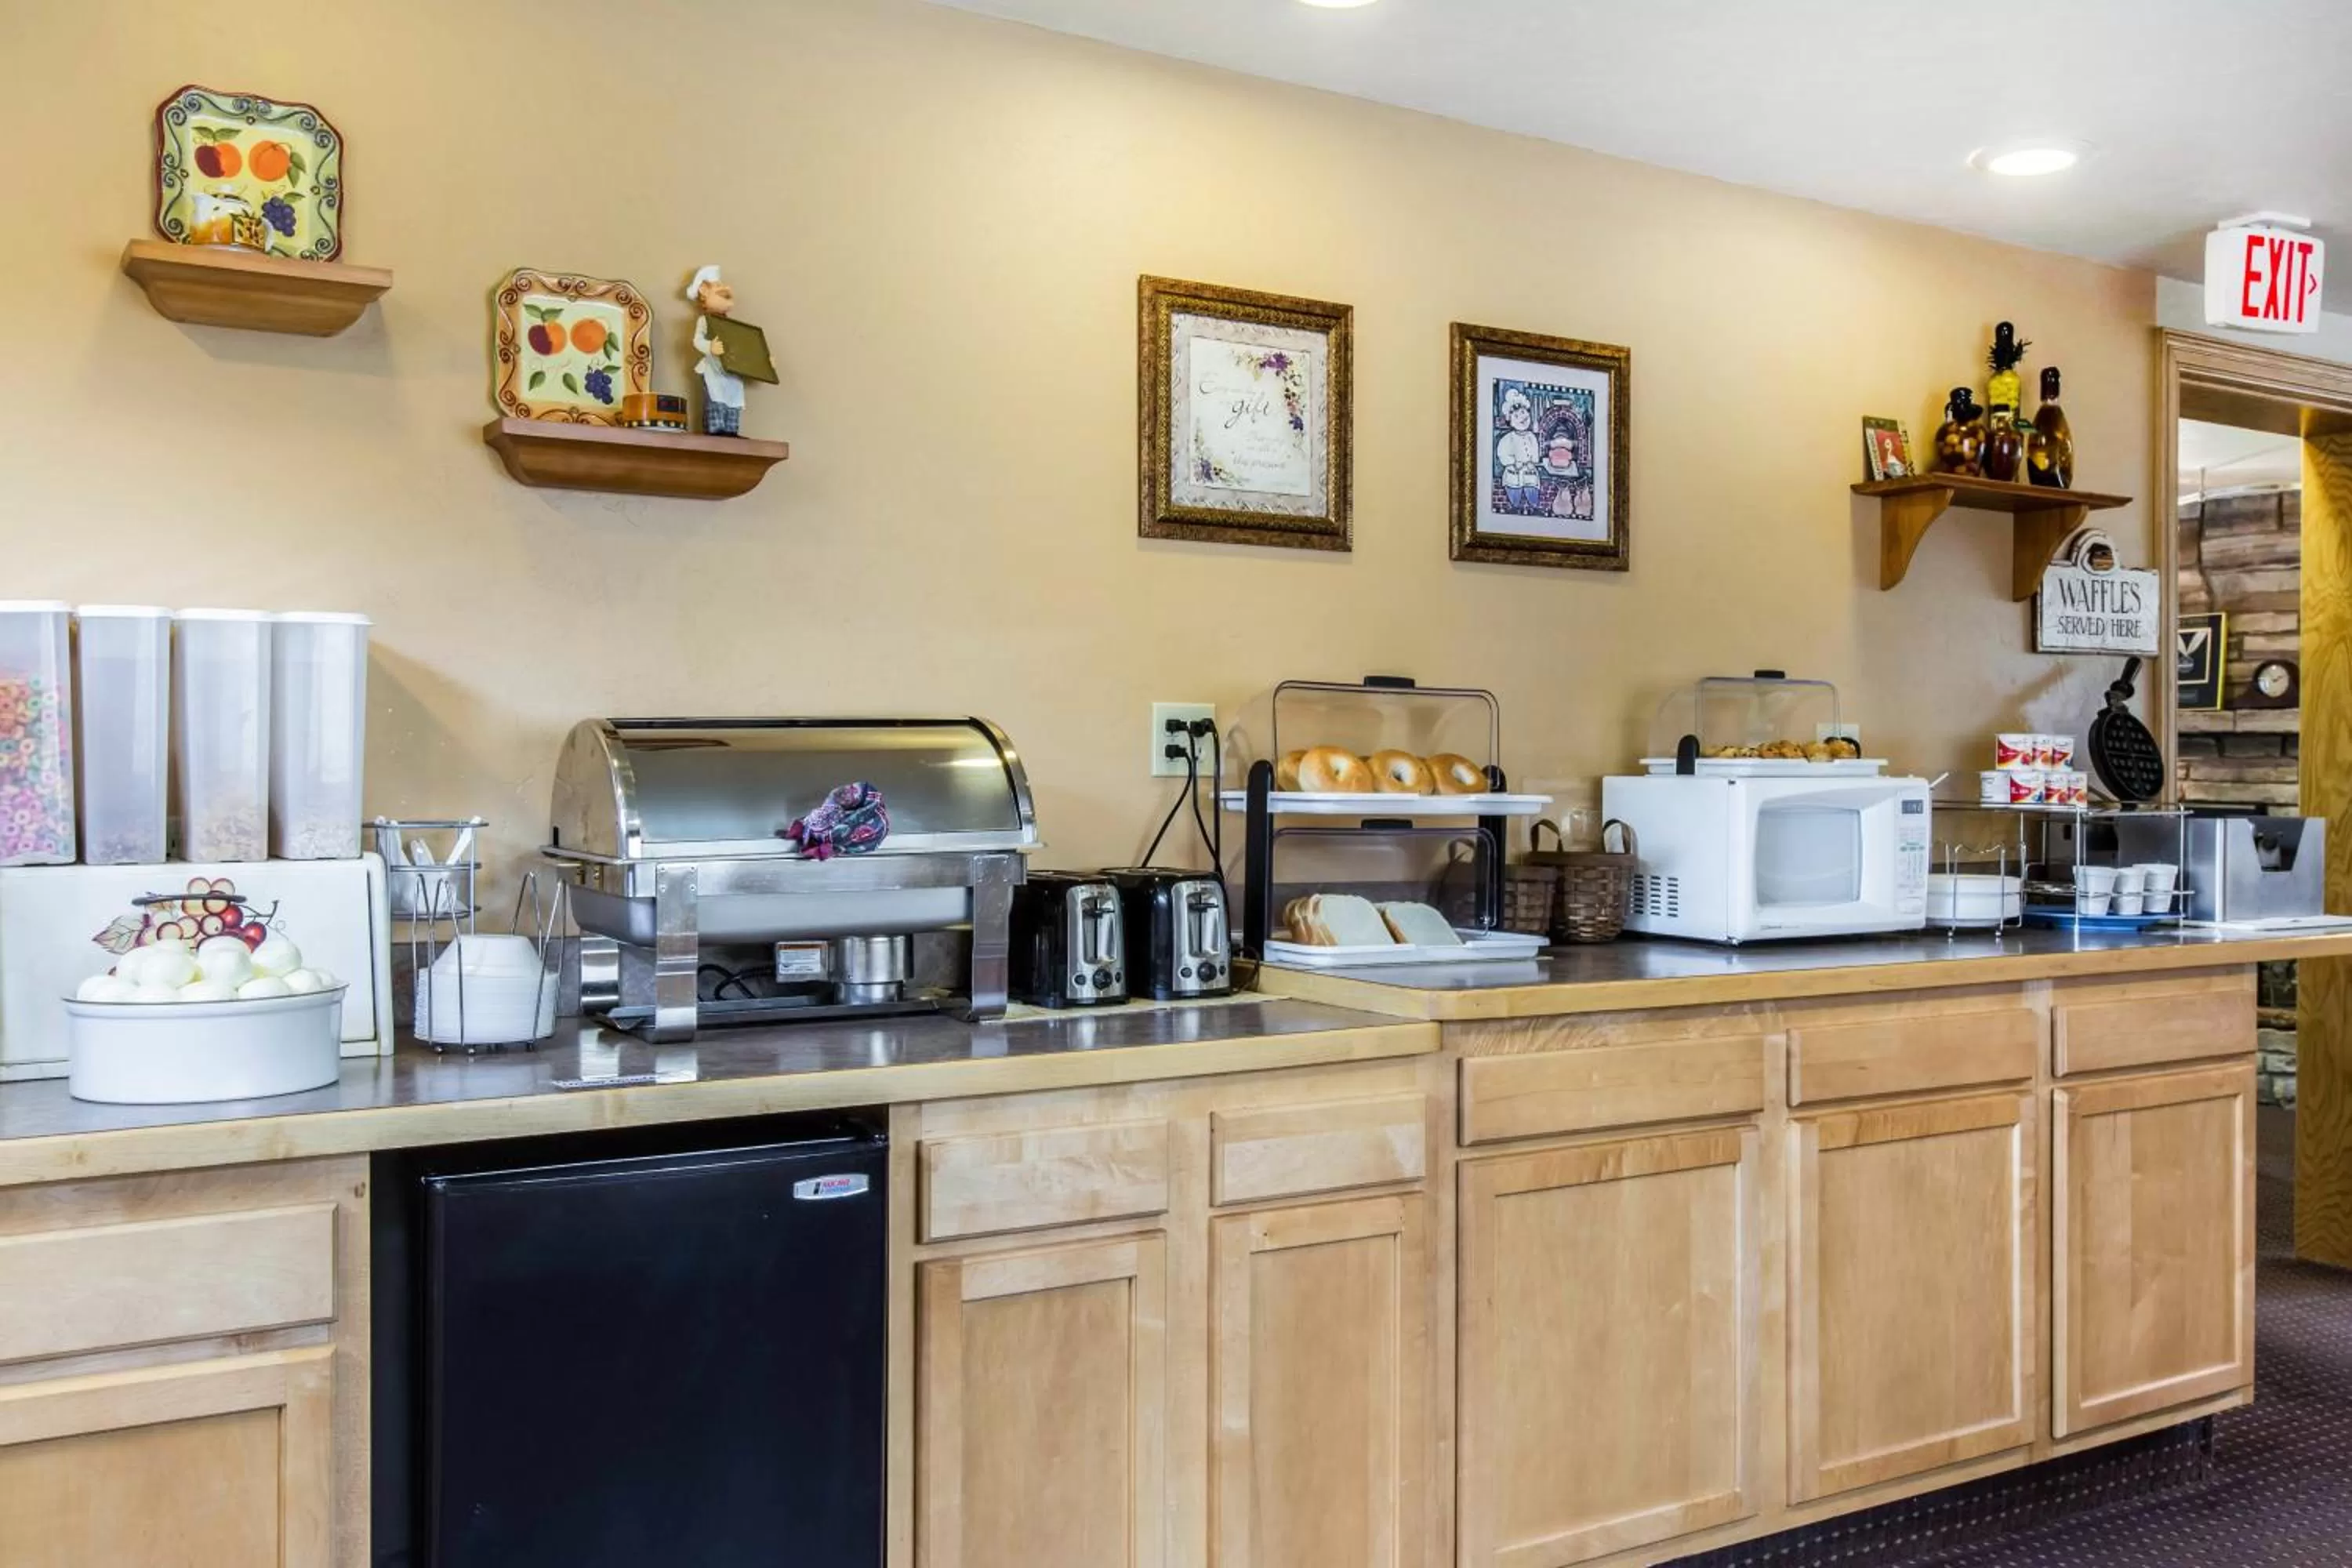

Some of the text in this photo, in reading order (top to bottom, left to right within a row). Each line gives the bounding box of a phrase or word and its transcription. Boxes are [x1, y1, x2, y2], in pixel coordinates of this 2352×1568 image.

[2241, 234, 2314, 323] EXIT
[2058, 578, 2141, 614] WAFFLES
[2057, 615, 2142, 638] SERVED HERE
